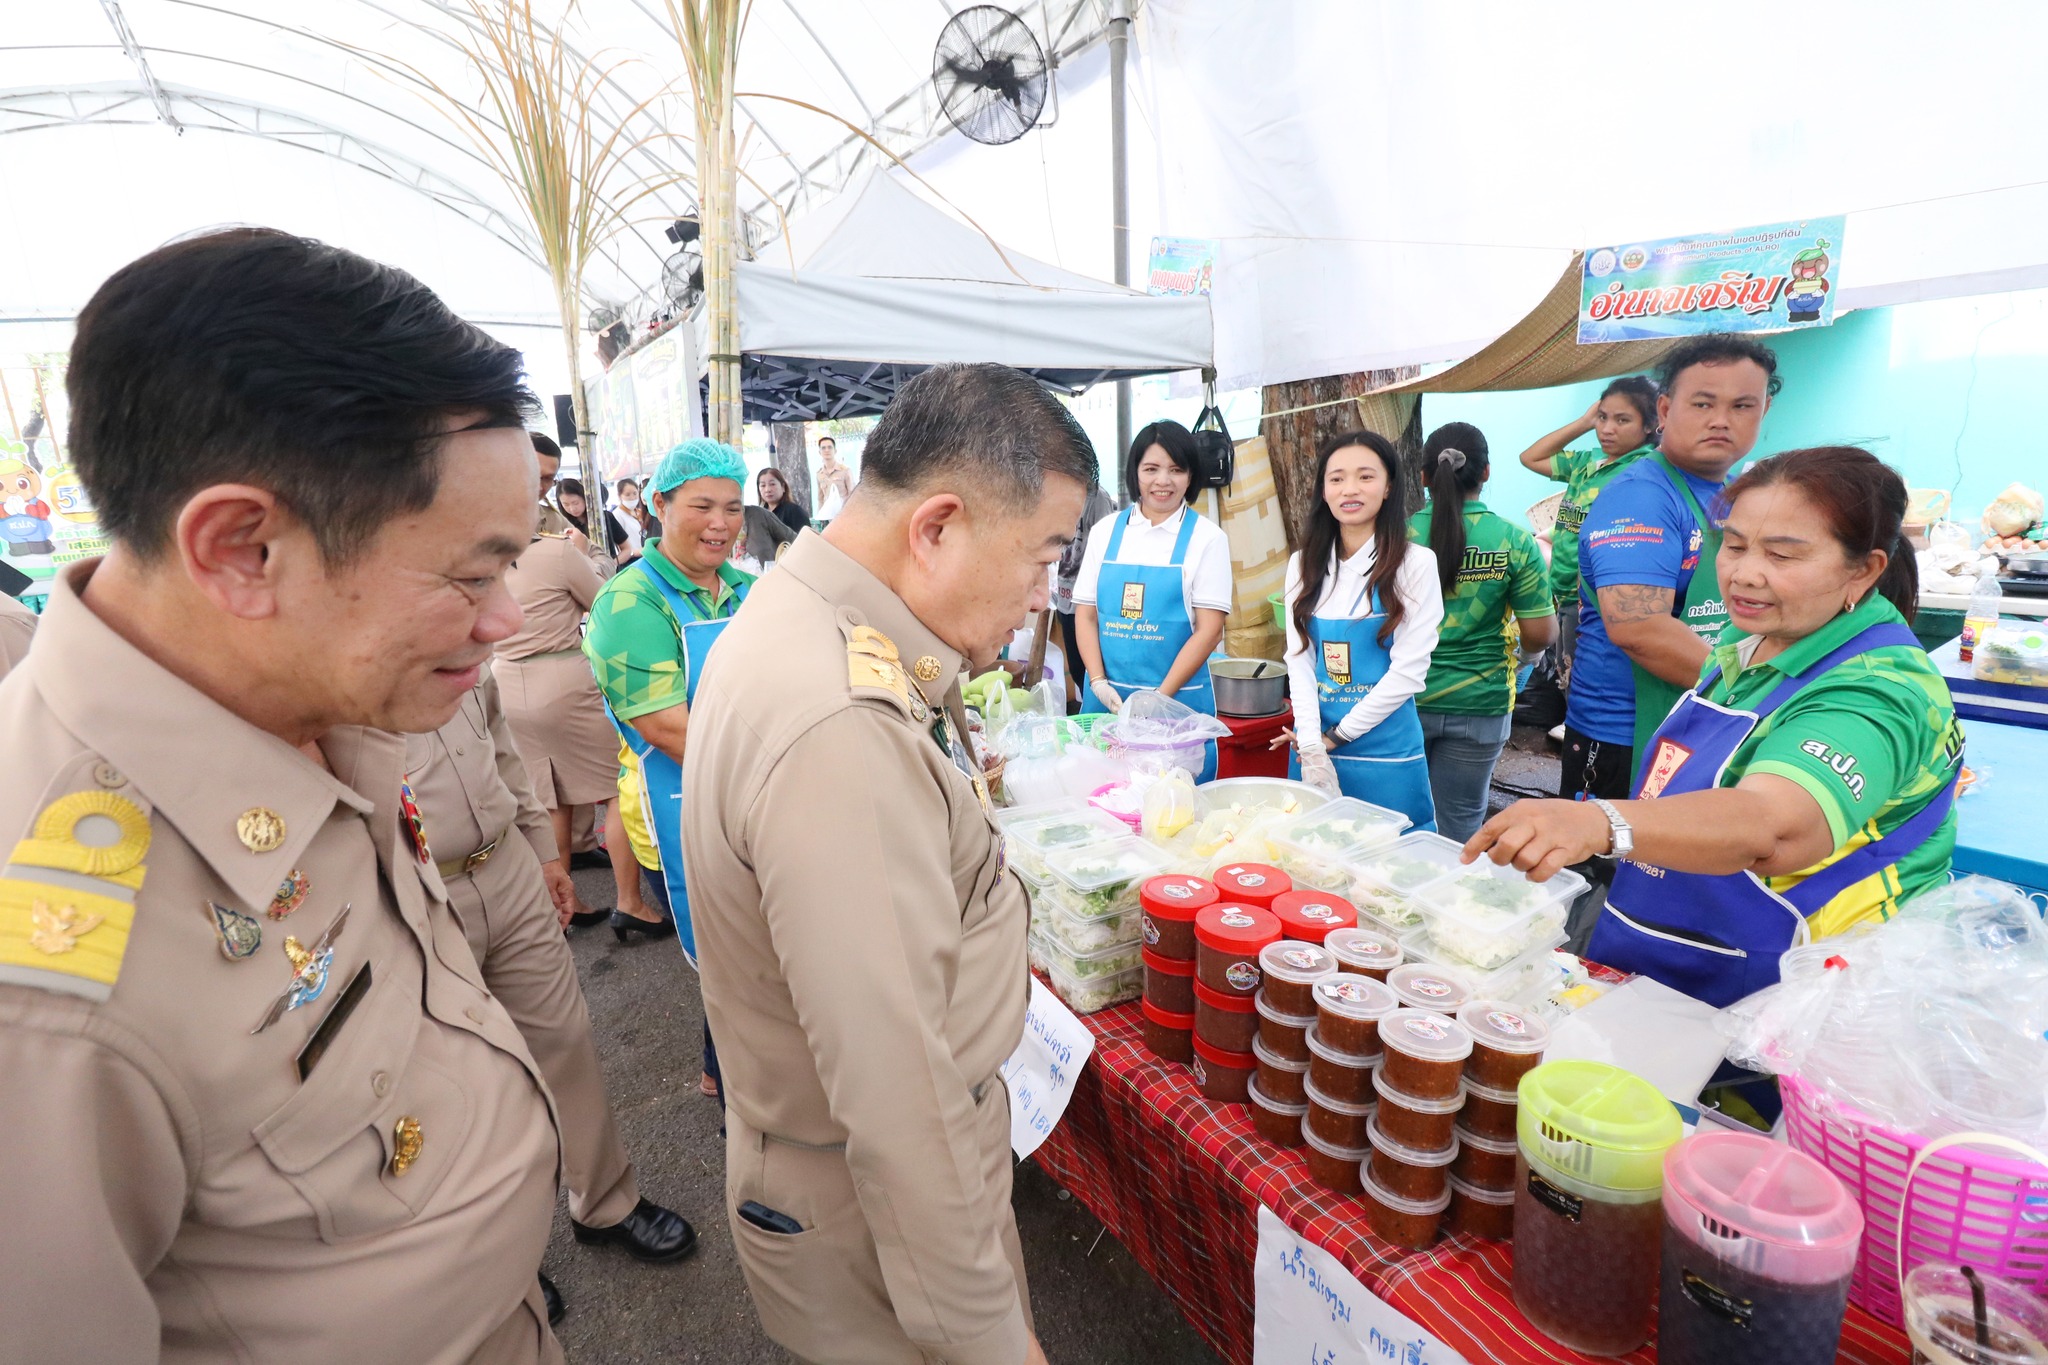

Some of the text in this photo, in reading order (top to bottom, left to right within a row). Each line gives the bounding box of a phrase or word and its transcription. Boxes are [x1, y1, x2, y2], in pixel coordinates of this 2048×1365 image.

[1709, 247, 1742, 258] Products
[1588, 271, 1785, 319] อำนาจเจริญ
[1801, 740, 1865, 802] ส.ป.ก.
[1029, 1107, 1051, 1136] 150
[1280, 1245, 1351, 1323] น้ำมะตูม
